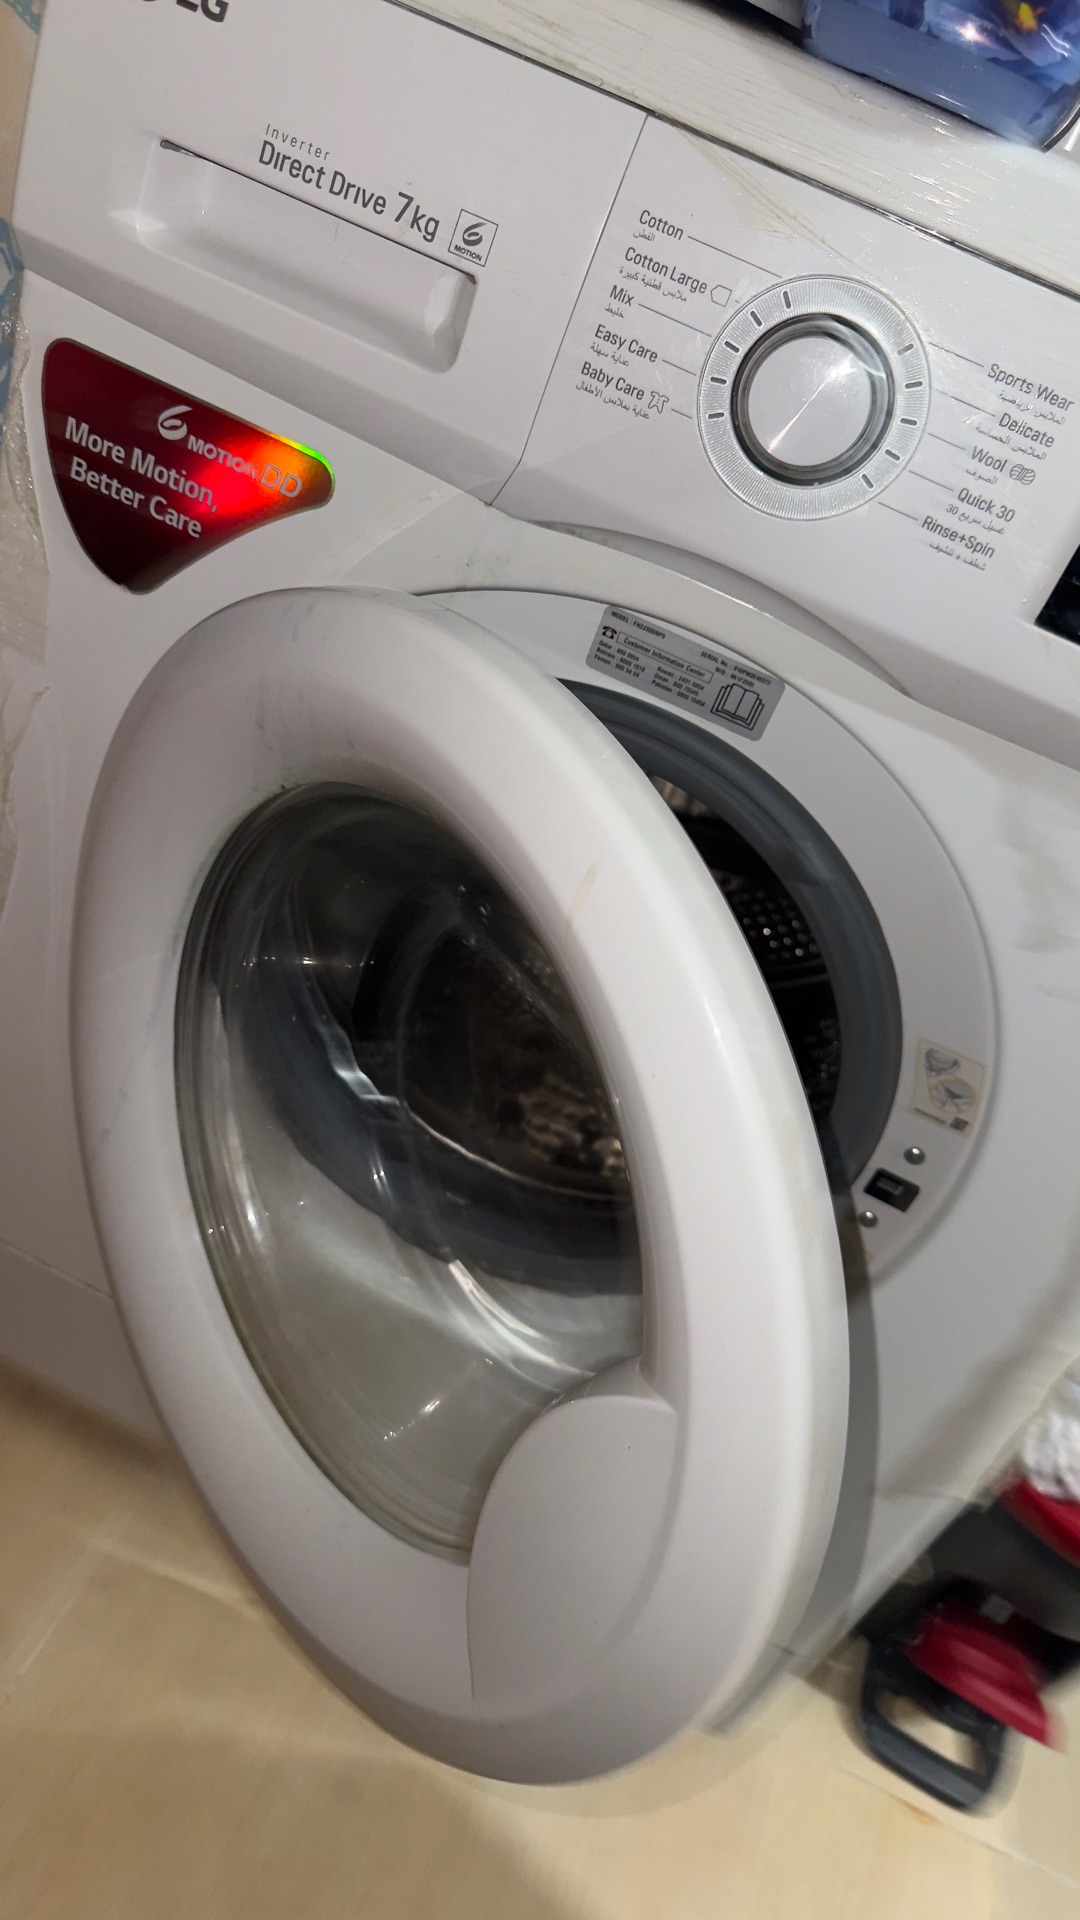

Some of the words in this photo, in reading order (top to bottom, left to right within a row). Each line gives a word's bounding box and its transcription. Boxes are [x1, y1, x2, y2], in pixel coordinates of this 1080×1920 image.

[265, 123, 331, 161] Inverter
[258, 140, 325, 189] Direct
[329, 170, 386, 215] Drive
[394, 192, 440, 243] 7kg
[633, 229, 655, 242] القطن
[639, 210, 684, 240] Cotton
[454, 244, 483, 262] MOTION
[625, 247, 668, 277] Cotton
[670, 267, 707, 294] Large
[641, 274, 662, 290] قطنية
[610, 285, 634, 307] Mix
[662, 287, 687, 302] ملابس
[605, 303, 624, 319] خليط
[595, 324, 627, 350] Easy
[628, 340, 658, 362] Care
[611, 351, 629, 366] عناية
[581, 361, 614, 388] Baby
[615, 377, 645, 400] Care
[987, 363, 1034, 394] Sports
[1035, 384, 1075, 411] Wear
[632, 405, 650, 419] عناية
[998, 412, 1055, 448] Delicate
[65, 416, 125, 464] More
[130, 447, 217, 513] Motion,
[187, 435, 258, 480] MOTION
[259, 463, 302, 498] DD
[971, 446, 1008, 472] Wool
[70, 456, 145, 510] Better
[150, 496, 202, 538] Care
[946, 504, 958, 515] 30
[957, 488, 996, 515] Quick
[996, 505, 1015, 522] 30
[921, 515, 995, 559] Rinse+Spin
[611, 611, 629, 623] MODEL
[624, 637, 651, 653] Customer
[652, 650, 684, 669] Information
[685, 665, 705, 678] Center
[701, 651, 719, 664] SERIAL
